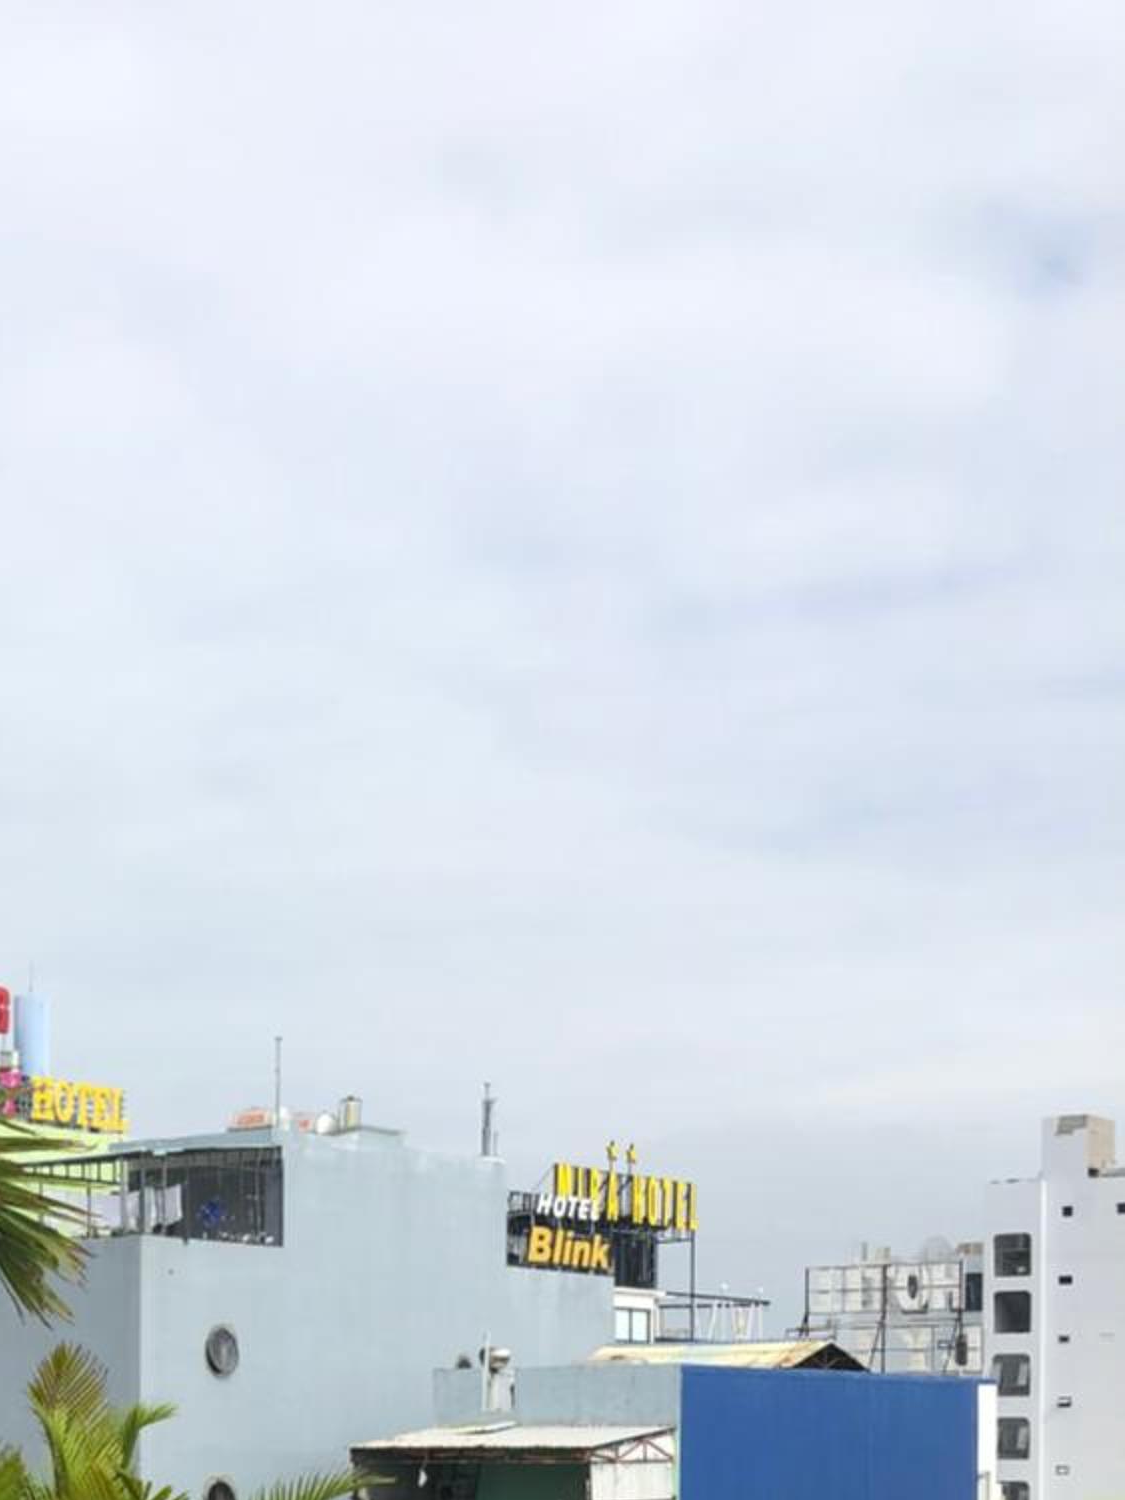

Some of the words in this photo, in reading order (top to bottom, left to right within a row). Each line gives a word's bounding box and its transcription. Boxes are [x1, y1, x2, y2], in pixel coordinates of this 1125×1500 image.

[31, 1076, 125, 1132] HOTEL
[536, 1192, 601, 1221] HOTEL
[632, 1174, 698, 1230] HOTEL
[528, 1225, 610, 1269] Blink
